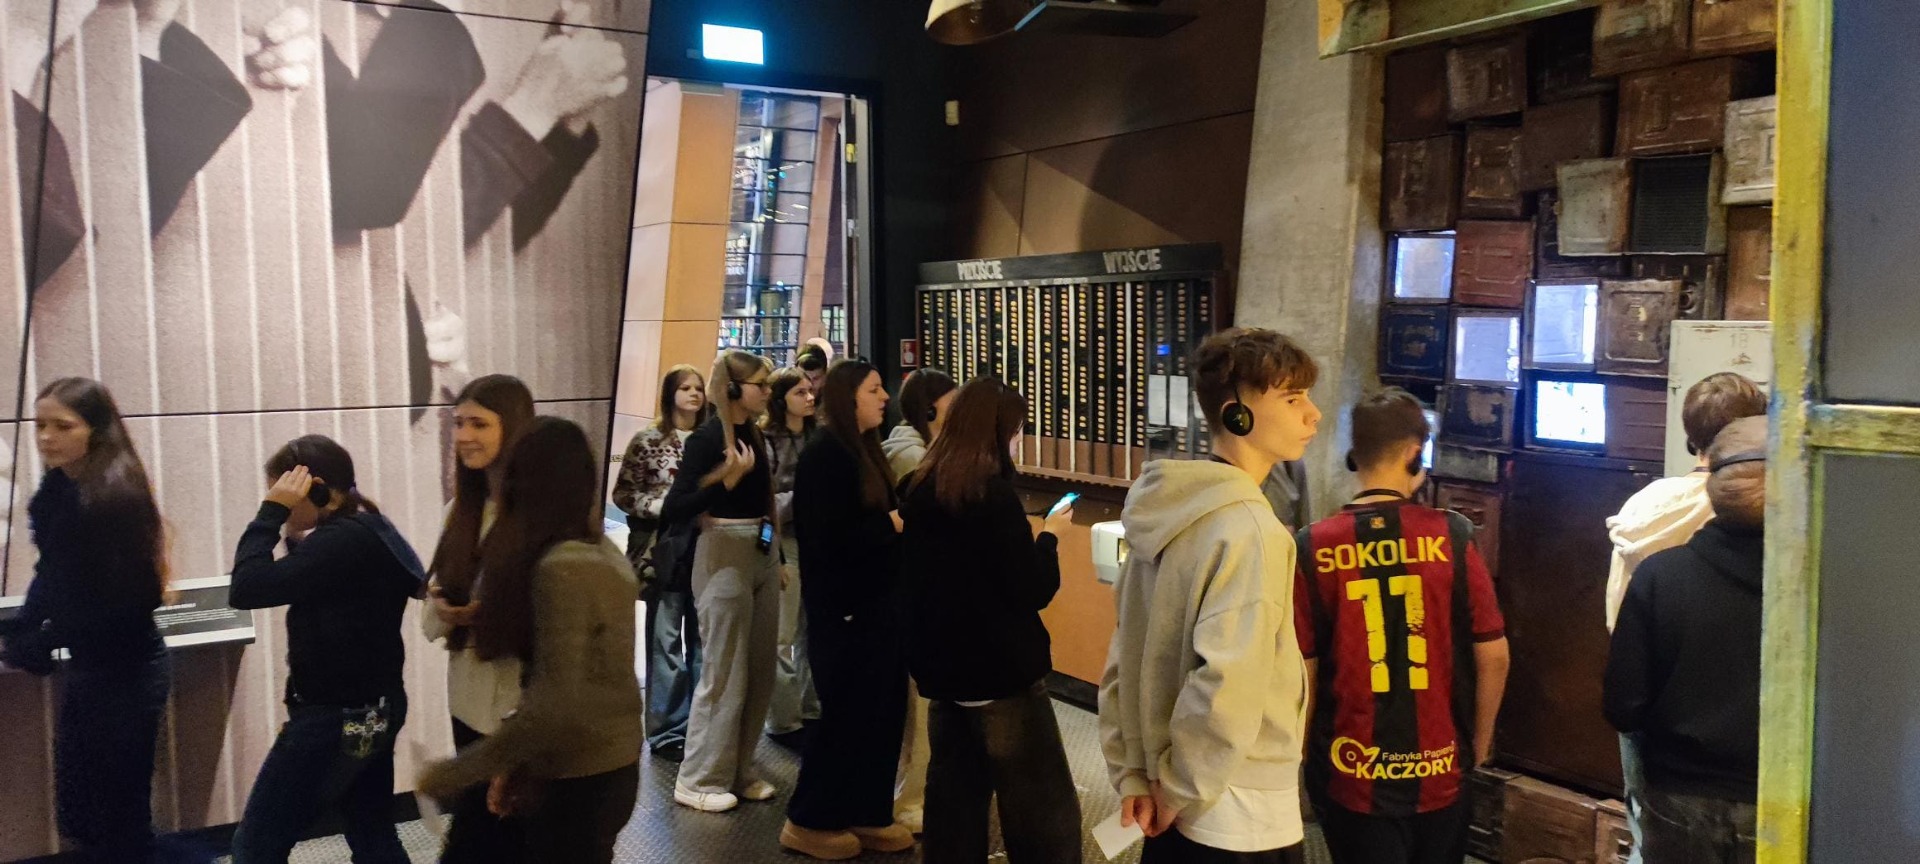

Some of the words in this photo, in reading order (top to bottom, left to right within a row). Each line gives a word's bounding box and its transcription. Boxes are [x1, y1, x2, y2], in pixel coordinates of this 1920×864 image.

[1102, 248, 1162, 274] WYJŚCIE
[1315, 536, 1449, 573] SOKOLIK
[1345, 575, 1429, 693] 11
[1355, 754, 1454, 780] KACZORY
[1382, 751, 1422, 762] Fabryka
